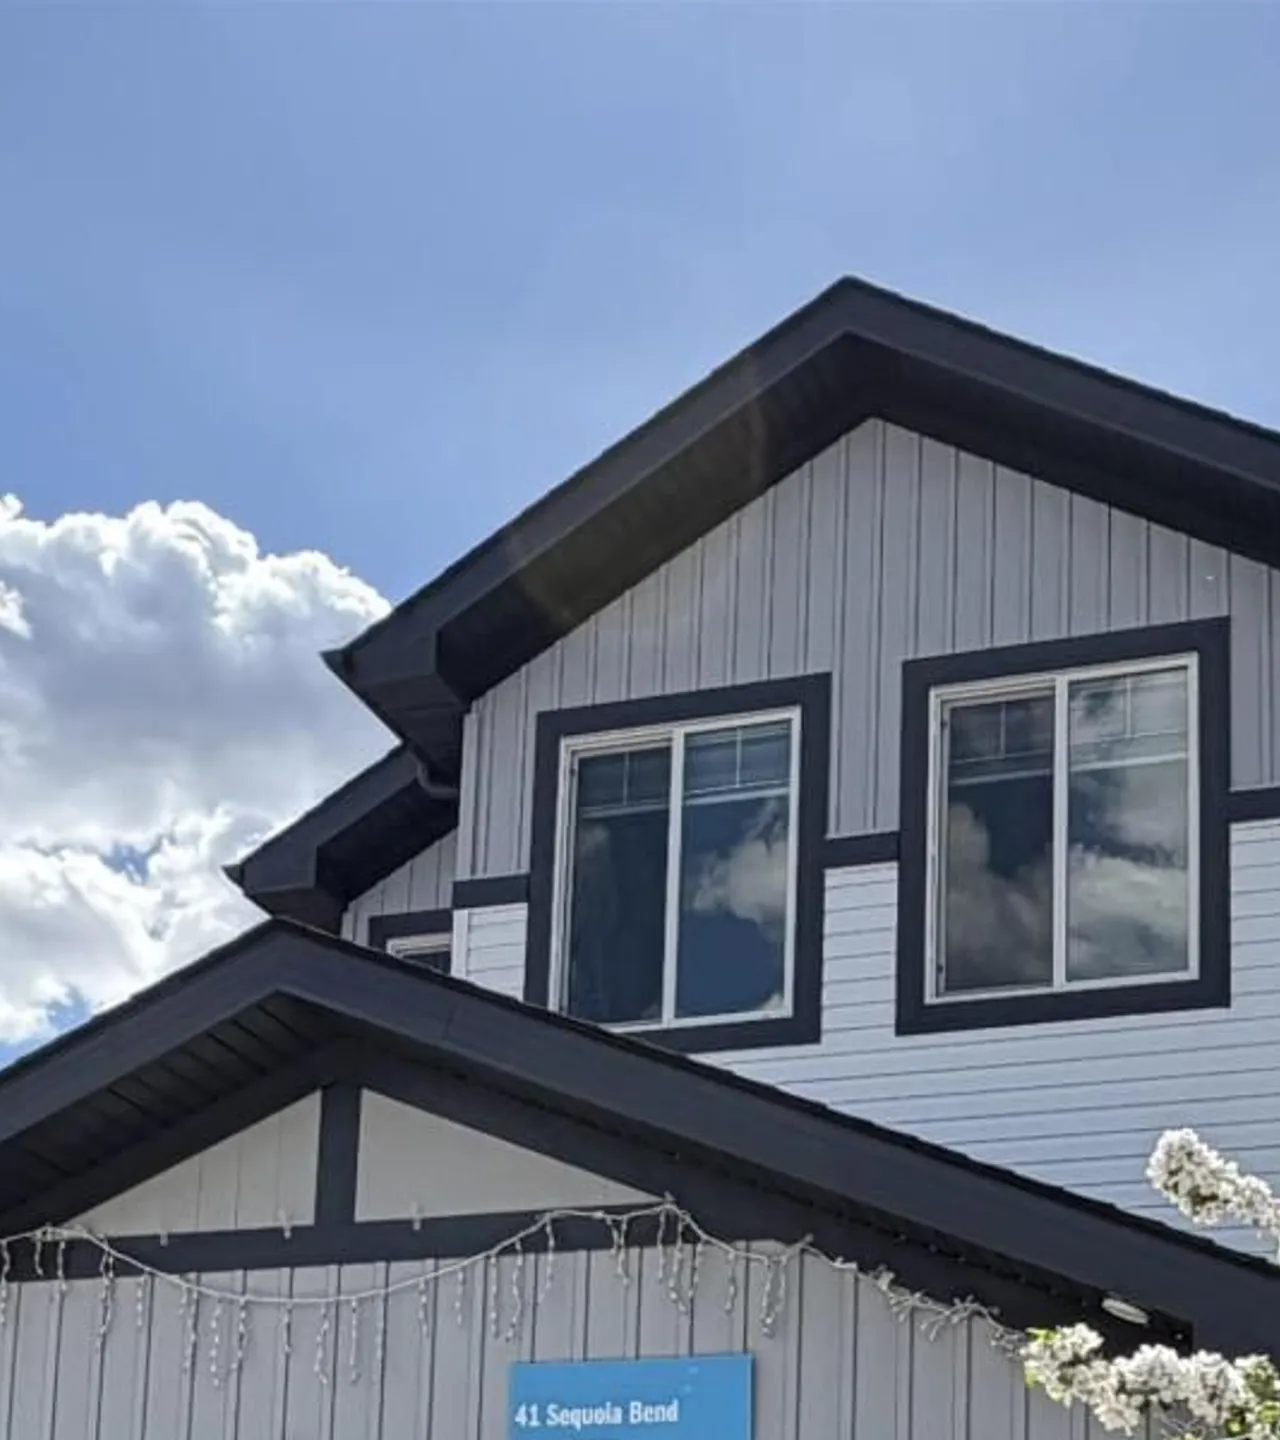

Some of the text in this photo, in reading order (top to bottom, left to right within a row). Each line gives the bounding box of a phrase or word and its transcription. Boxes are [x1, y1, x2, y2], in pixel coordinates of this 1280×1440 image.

[515, 1399, 679, 1431] 41 Sequoia Bend
